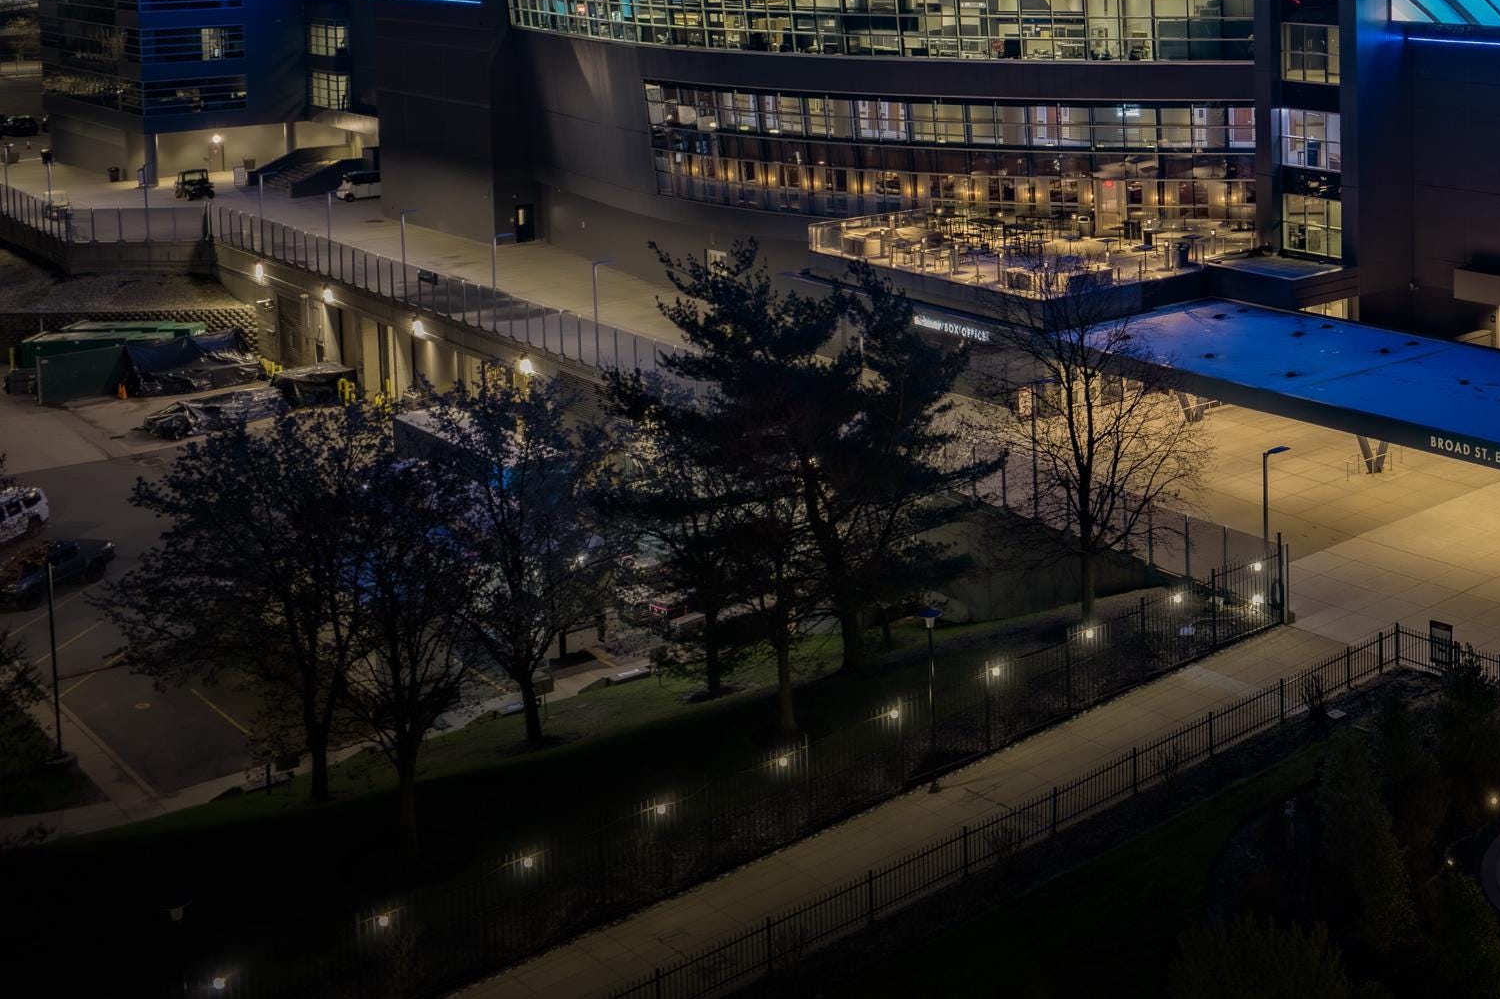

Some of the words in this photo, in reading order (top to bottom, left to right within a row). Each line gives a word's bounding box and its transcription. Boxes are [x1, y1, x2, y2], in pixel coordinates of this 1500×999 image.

[944, 322, 960, 335] BOX
[961, 327, 990, 342] OFFICE
[1430, 435, 1471, 456] BROAD
[1474, 446, 1491, 461] ST.
